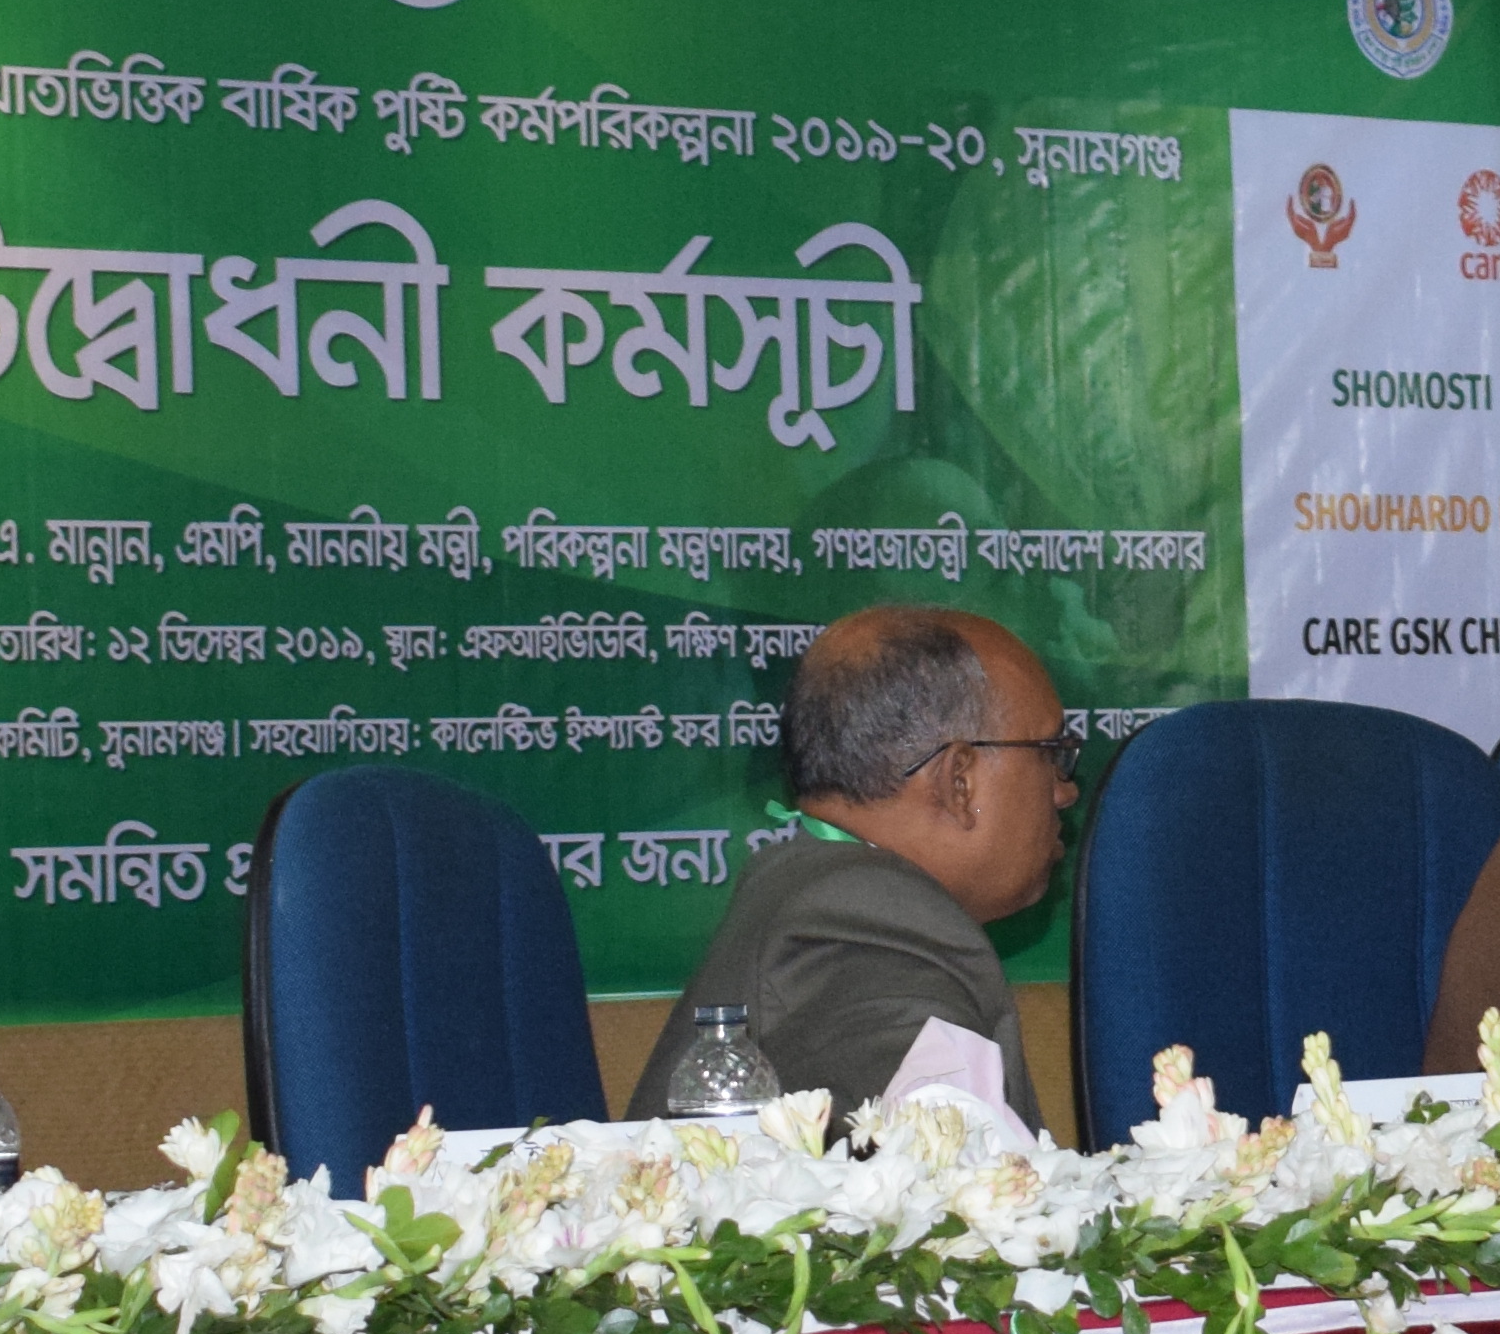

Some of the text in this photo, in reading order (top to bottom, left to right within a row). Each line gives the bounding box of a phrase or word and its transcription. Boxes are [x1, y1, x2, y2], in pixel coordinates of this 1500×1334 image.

[217, 64, 359, 133] বার্ষিক
[374, 73, 466, 154] পুষ্টি
[478, 82, 755, 165] কর্মপরিকল্পনা
[772, 114, 1004, 176] ২০১৯-২০,
[1015, 126, 1183, 189] সুনামগঞ্জ
[484, 221, 922, 451] কর্মসূচী
[1331, 369, 1493, 410] SHOMOSTI
[1293, 492, 1491, 533] SHOUHARDO
[46, 519, 165, 584] মান্নান,
[175, 502, 276, 573] এমপি,
[284, 504, 408, 573] মাননীয়
[416, 505, 493, 580] মন্ত্রী,
[502, 507, 649, 580] পরিকল্পনা
[657, 526, 803, 581] মন্ত্রণালয়,
[812, 511, 969, 582] গণপ্রজাতন্ত্রী
[975, 528, 1104, 575] বাংলাদেশ
[1110, 530, 1206, 571] সরকার
[107, 625, 152, 664] ১২
[158, 611, 266, 664] ডিসেম্বর
[276, 627, 375, 665] ২০১৯,
[457, 611, 658, 665] এফআইভিডিবি,
[665, 612, 737, 659] দক্ষিণ
[743, 624, 827, 669] সুনাম
[1303, 616, 1381, 656] CARE
[1389, 616, 1452, 655] GSK
[430, 702, 558, 753] কালেক্টিভ
[565, 704, 664, 752] ইম্প্যাক্ট
[670, 714, 720, 747] ফর
[728, 700, 786, 747] নিউ
[10, 820, 210, 907] সমন্বিত
[618, 829, 731, 886] জন্য
